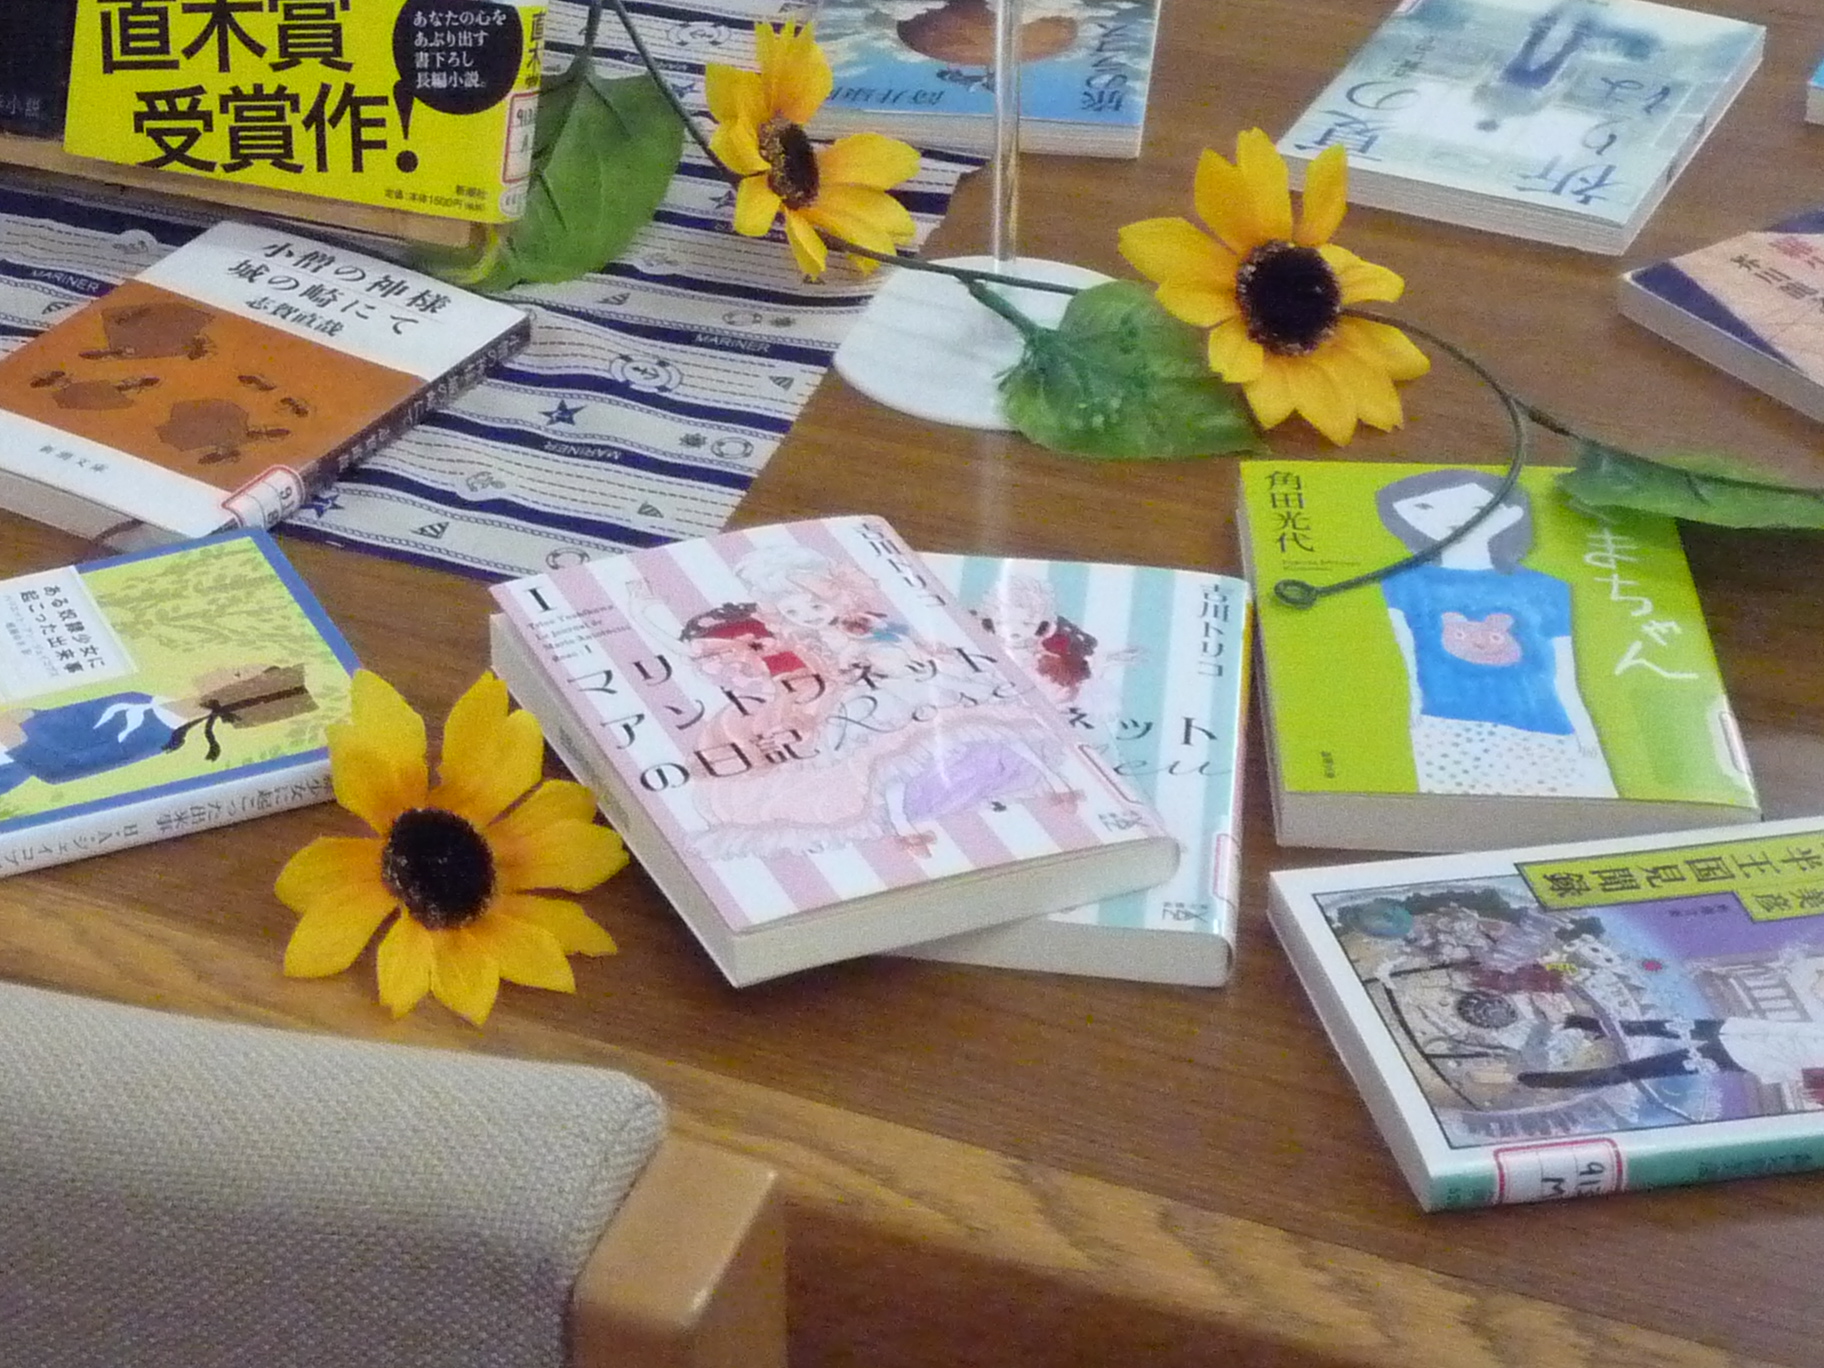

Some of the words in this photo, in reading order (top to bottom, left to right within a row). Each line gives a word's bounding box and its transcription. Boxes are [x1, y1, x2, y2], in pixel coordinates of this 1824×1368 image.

[411, 6, 508, 30] あなたの心を
[412, 28, 489, 50] あぶり出す
[414, 49, 476, 69] 書下ろし
[132, 77, 421, 175] 受賞作!
[32, 268, 102, 294] MARINER
[263, 241, 452, 315] 小僧の神様
[245, 295, 345, 338] 志賀直哉
[694, 332, 772, 355] MARINER
[1265, 470, 1316, 554] 角田光代
[854, 521, 949, 609] 吉川トリコ
[1197, 583, 1236, 678] 吉川トリコ
[1582, 530, 1700, 683] まちゃん
[600, 645, 998, 750] アントワネット
[638, 728, 821, 792] の日記
[1542, 840, 1824, 899] 半王国見聞録
